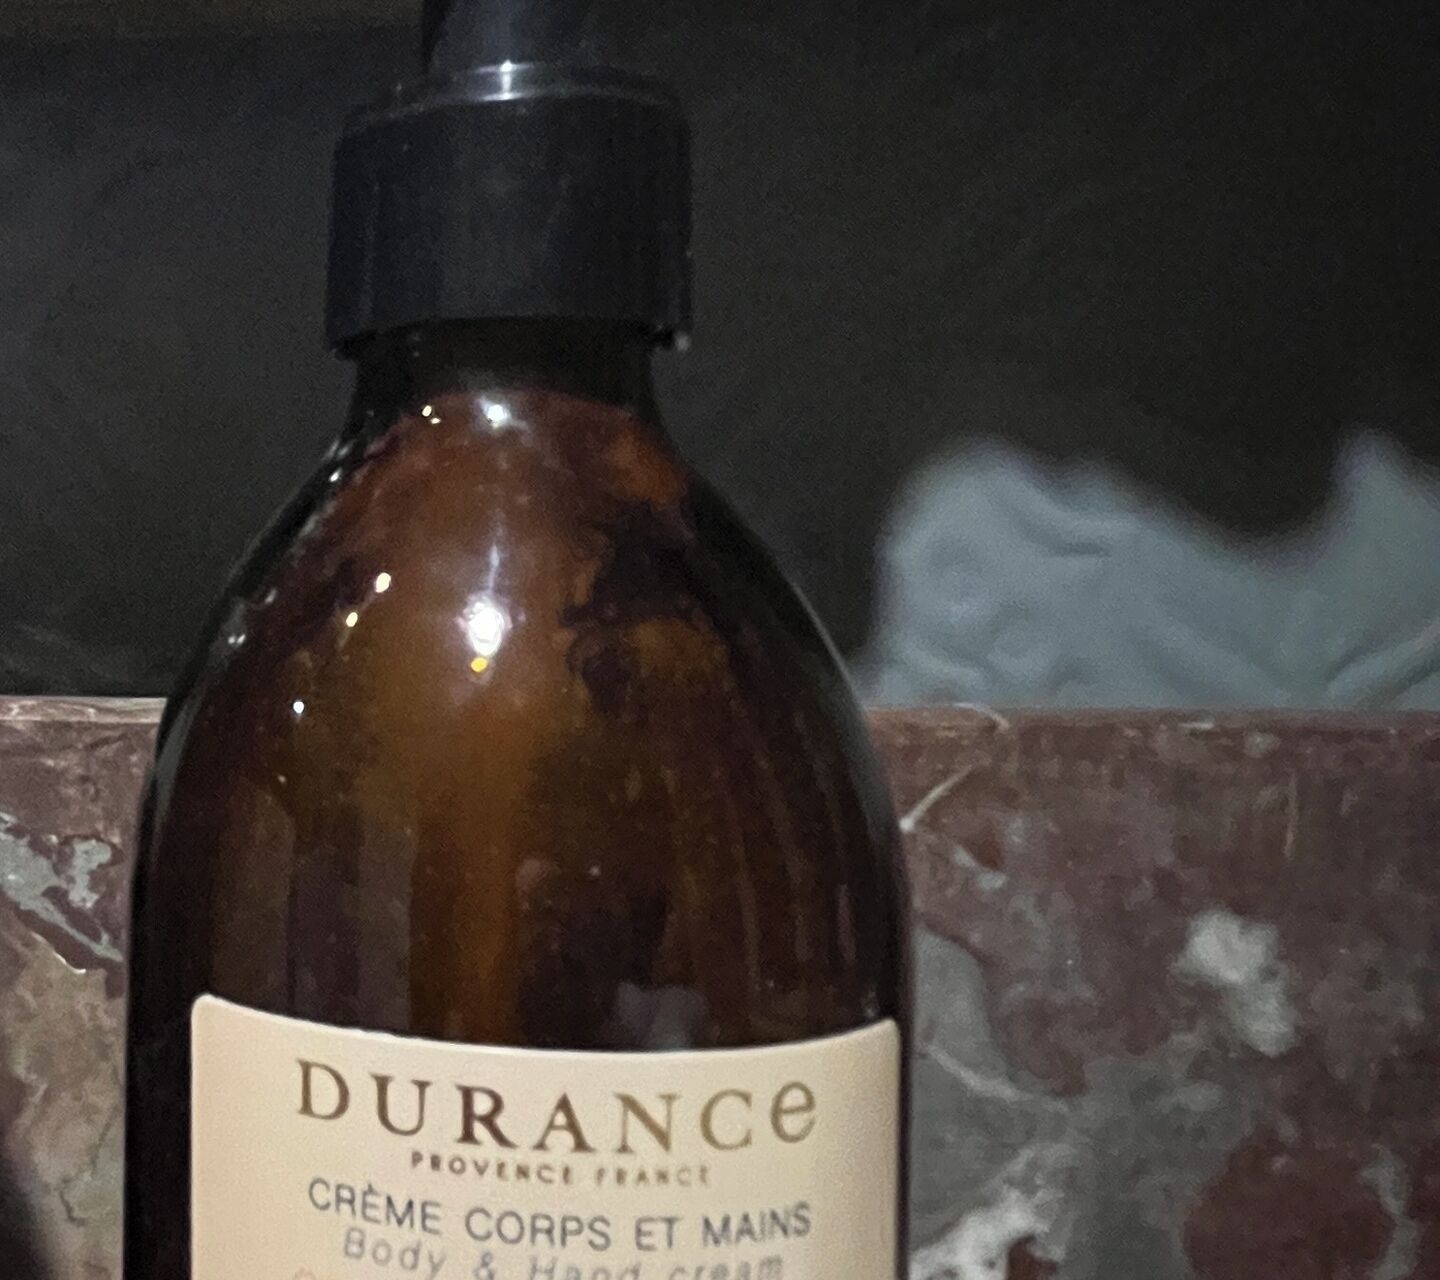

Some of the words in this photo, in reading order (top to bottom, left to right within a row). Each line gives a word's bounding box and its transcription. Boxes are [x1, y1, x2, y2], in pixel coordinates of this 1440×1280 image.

[411, 1150, 572, 1185] PROVENCE
[594, 1163, 712, 1187] FRANCE
[308, 1177, 443, 1234] CRÈME
[465, 1207, 611, 1251] CORPS
[635, 1209, 678, 1249] ET
[702, 1202, 812, 1246] MAINS
[343, 1226, 445, 1280] Body
[473, 1251, 496, 1280] &
